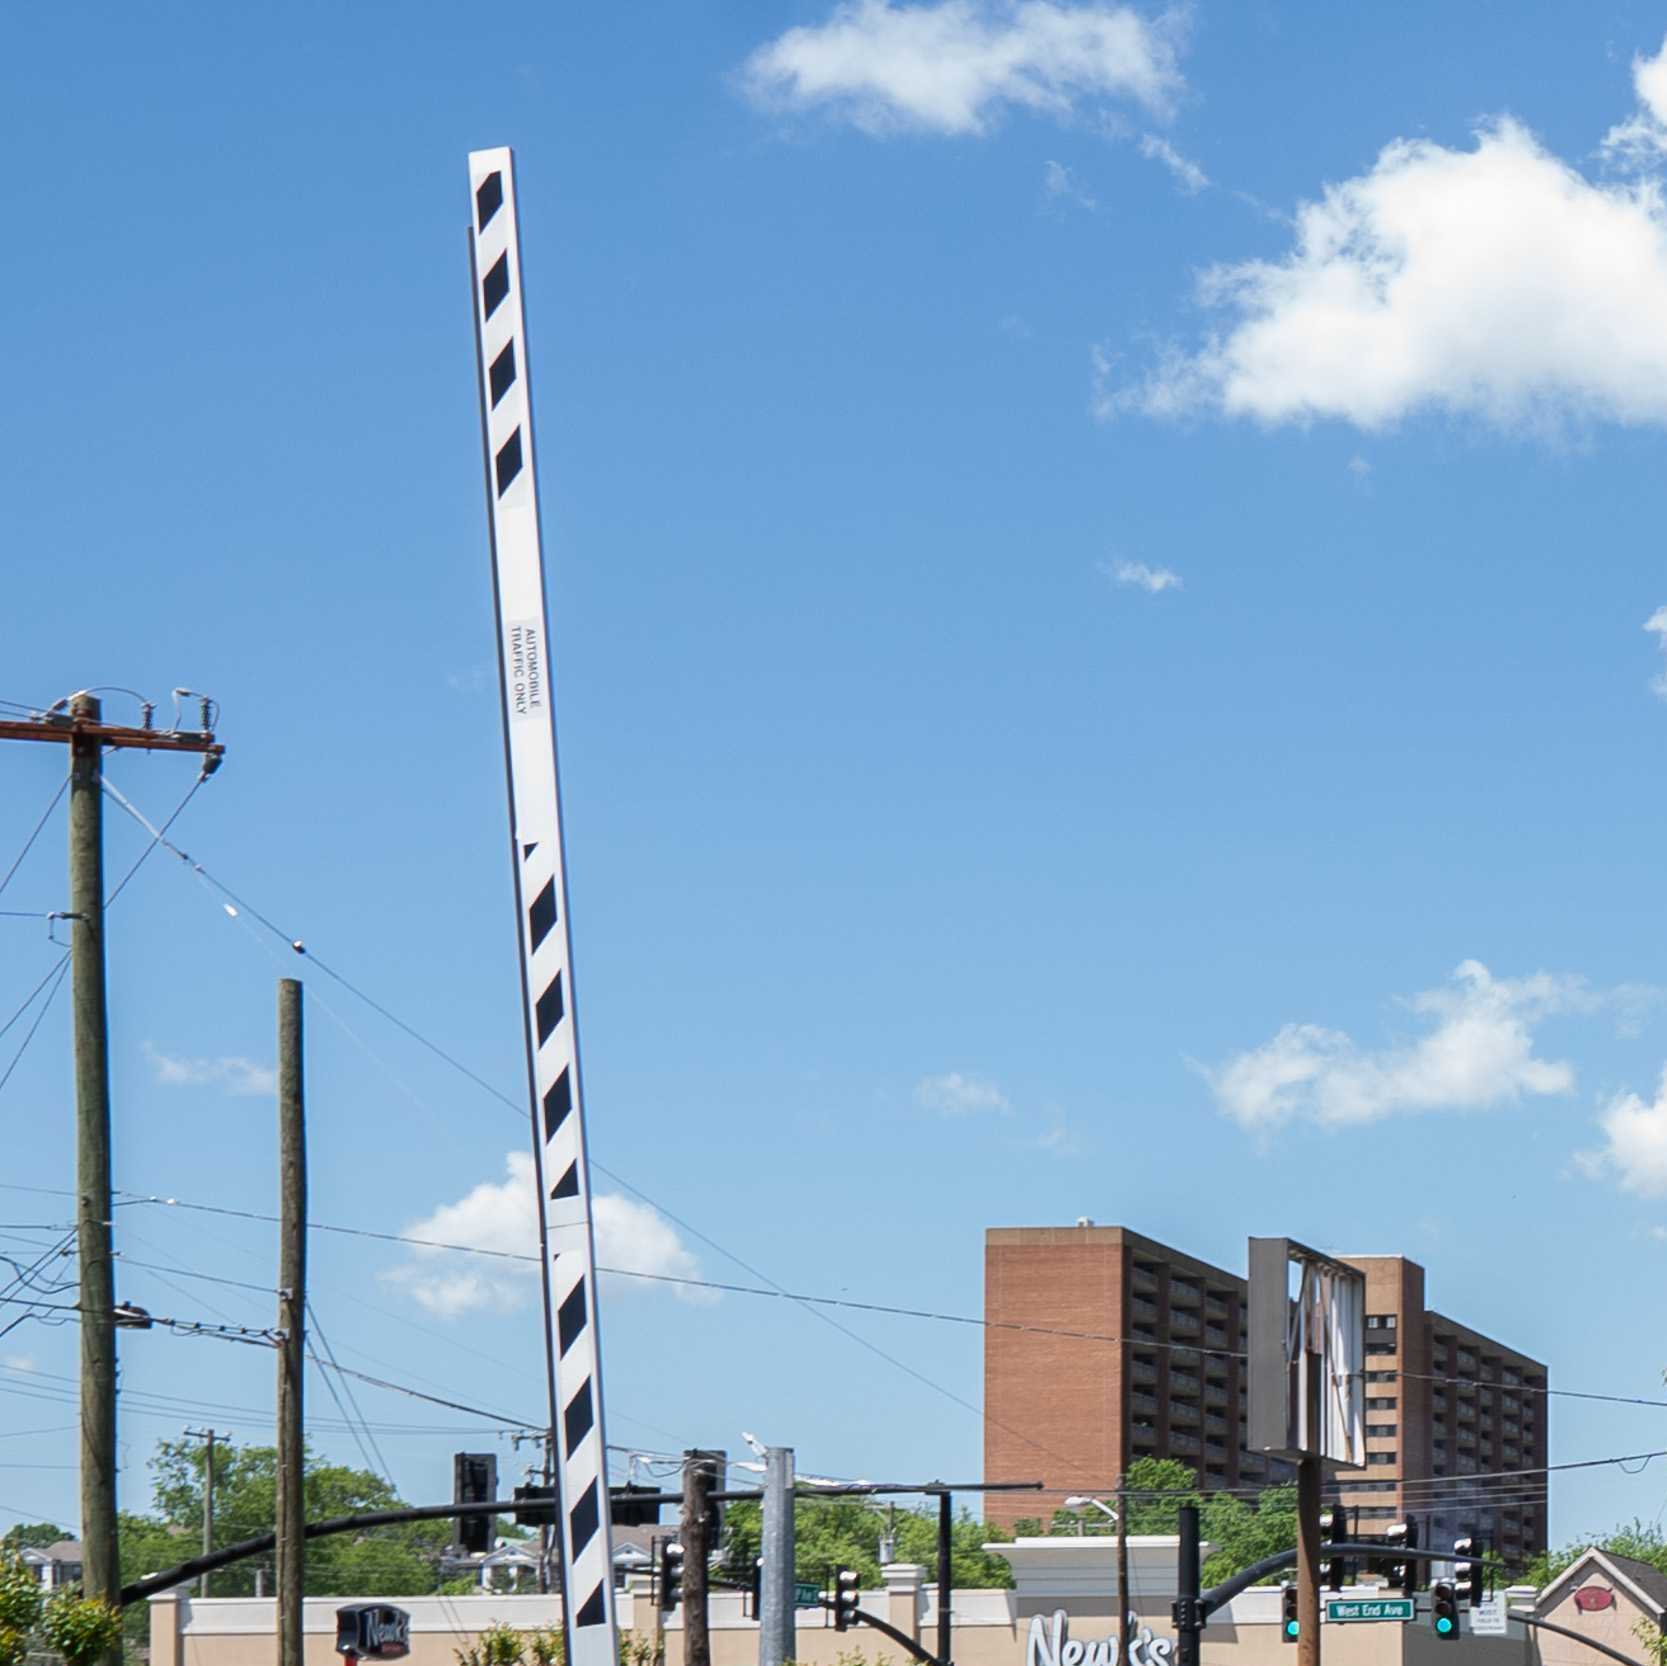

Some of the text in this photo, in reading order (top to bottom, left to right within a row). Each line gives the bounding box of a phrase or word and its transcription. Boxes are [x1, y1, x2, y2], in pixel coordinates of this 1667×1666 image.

[511, 626, 527, 714] TRAFFIC ONLY
[526, 628, 542, 708] AUTOMOBILE
[1336, 1604, 1404, 1617] West End Ave
